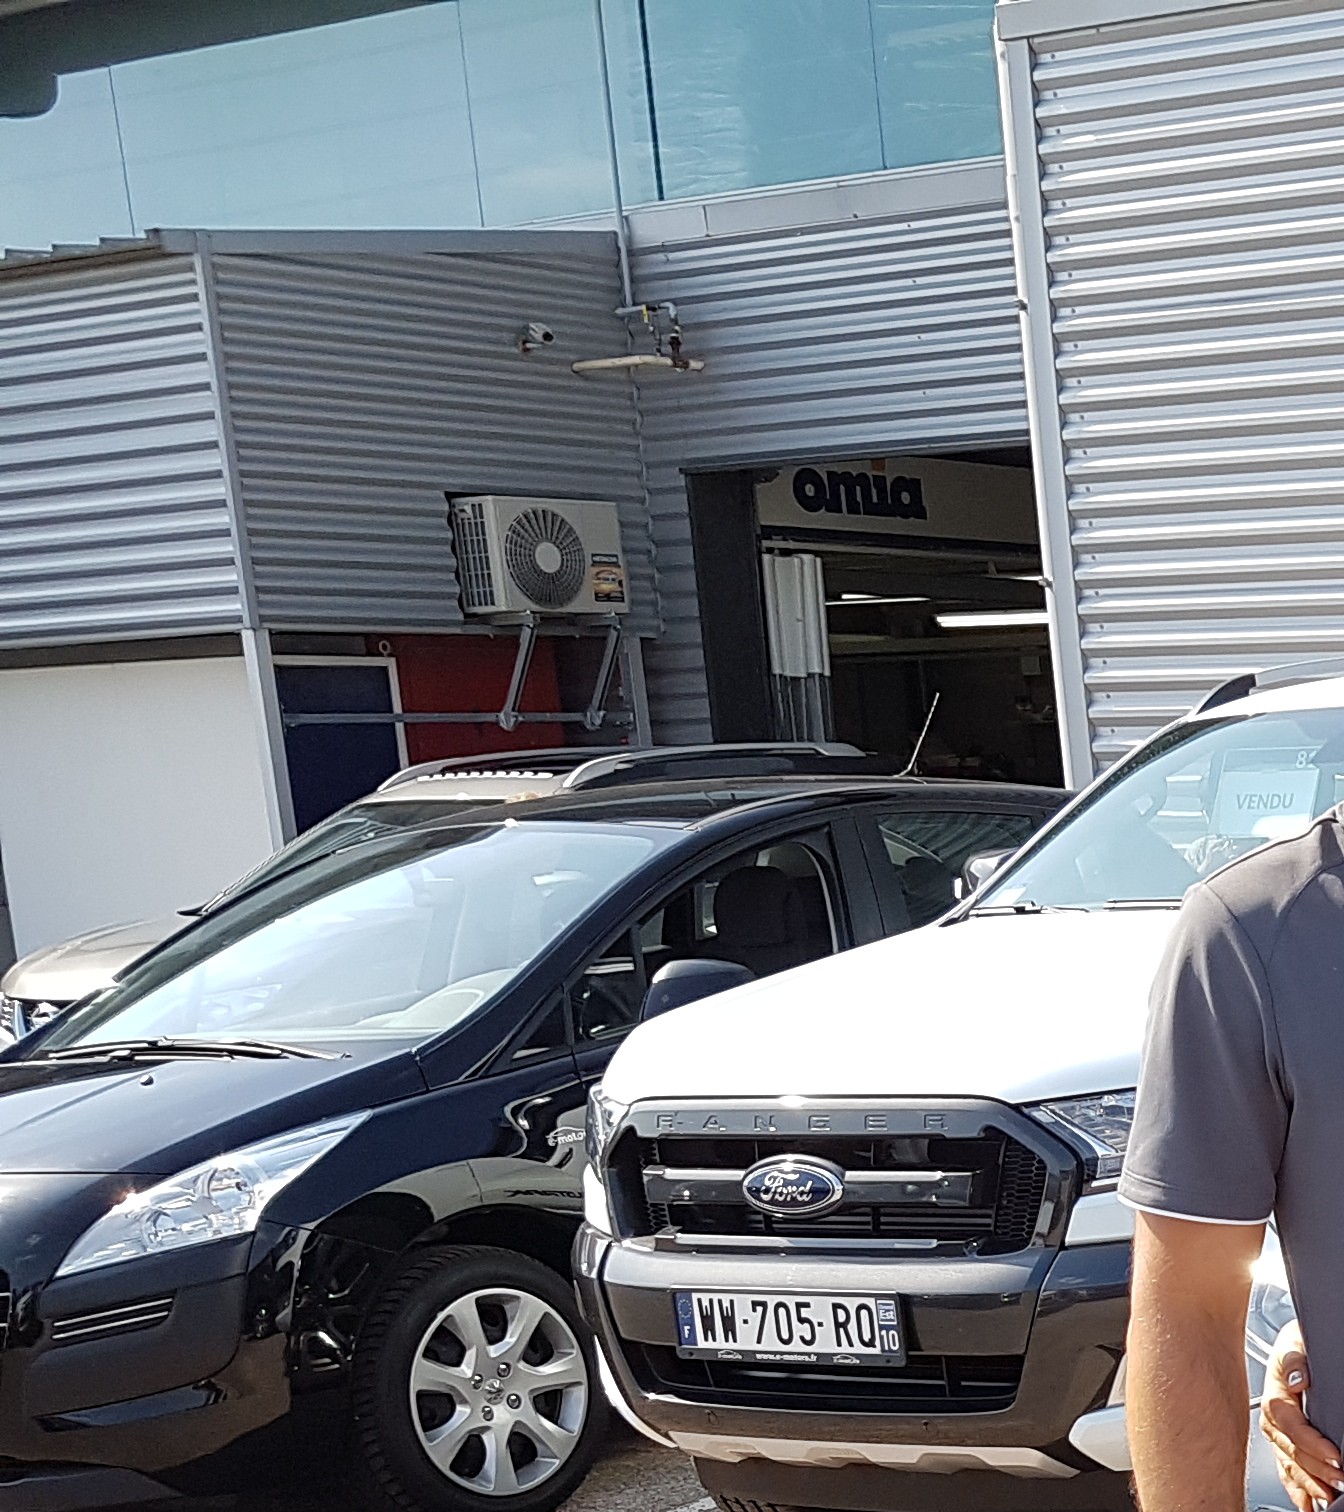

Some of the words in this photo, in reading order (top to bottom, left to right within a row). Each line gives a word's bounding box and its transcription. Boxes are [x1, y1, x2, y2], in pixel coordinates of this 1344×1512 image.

[793, 459, 928, 520] omia
[1236, 793, 1295, 810] VENDU
[760, 1171, 814, 1202] Ford
[881, 1329, 899, 1351] 10
